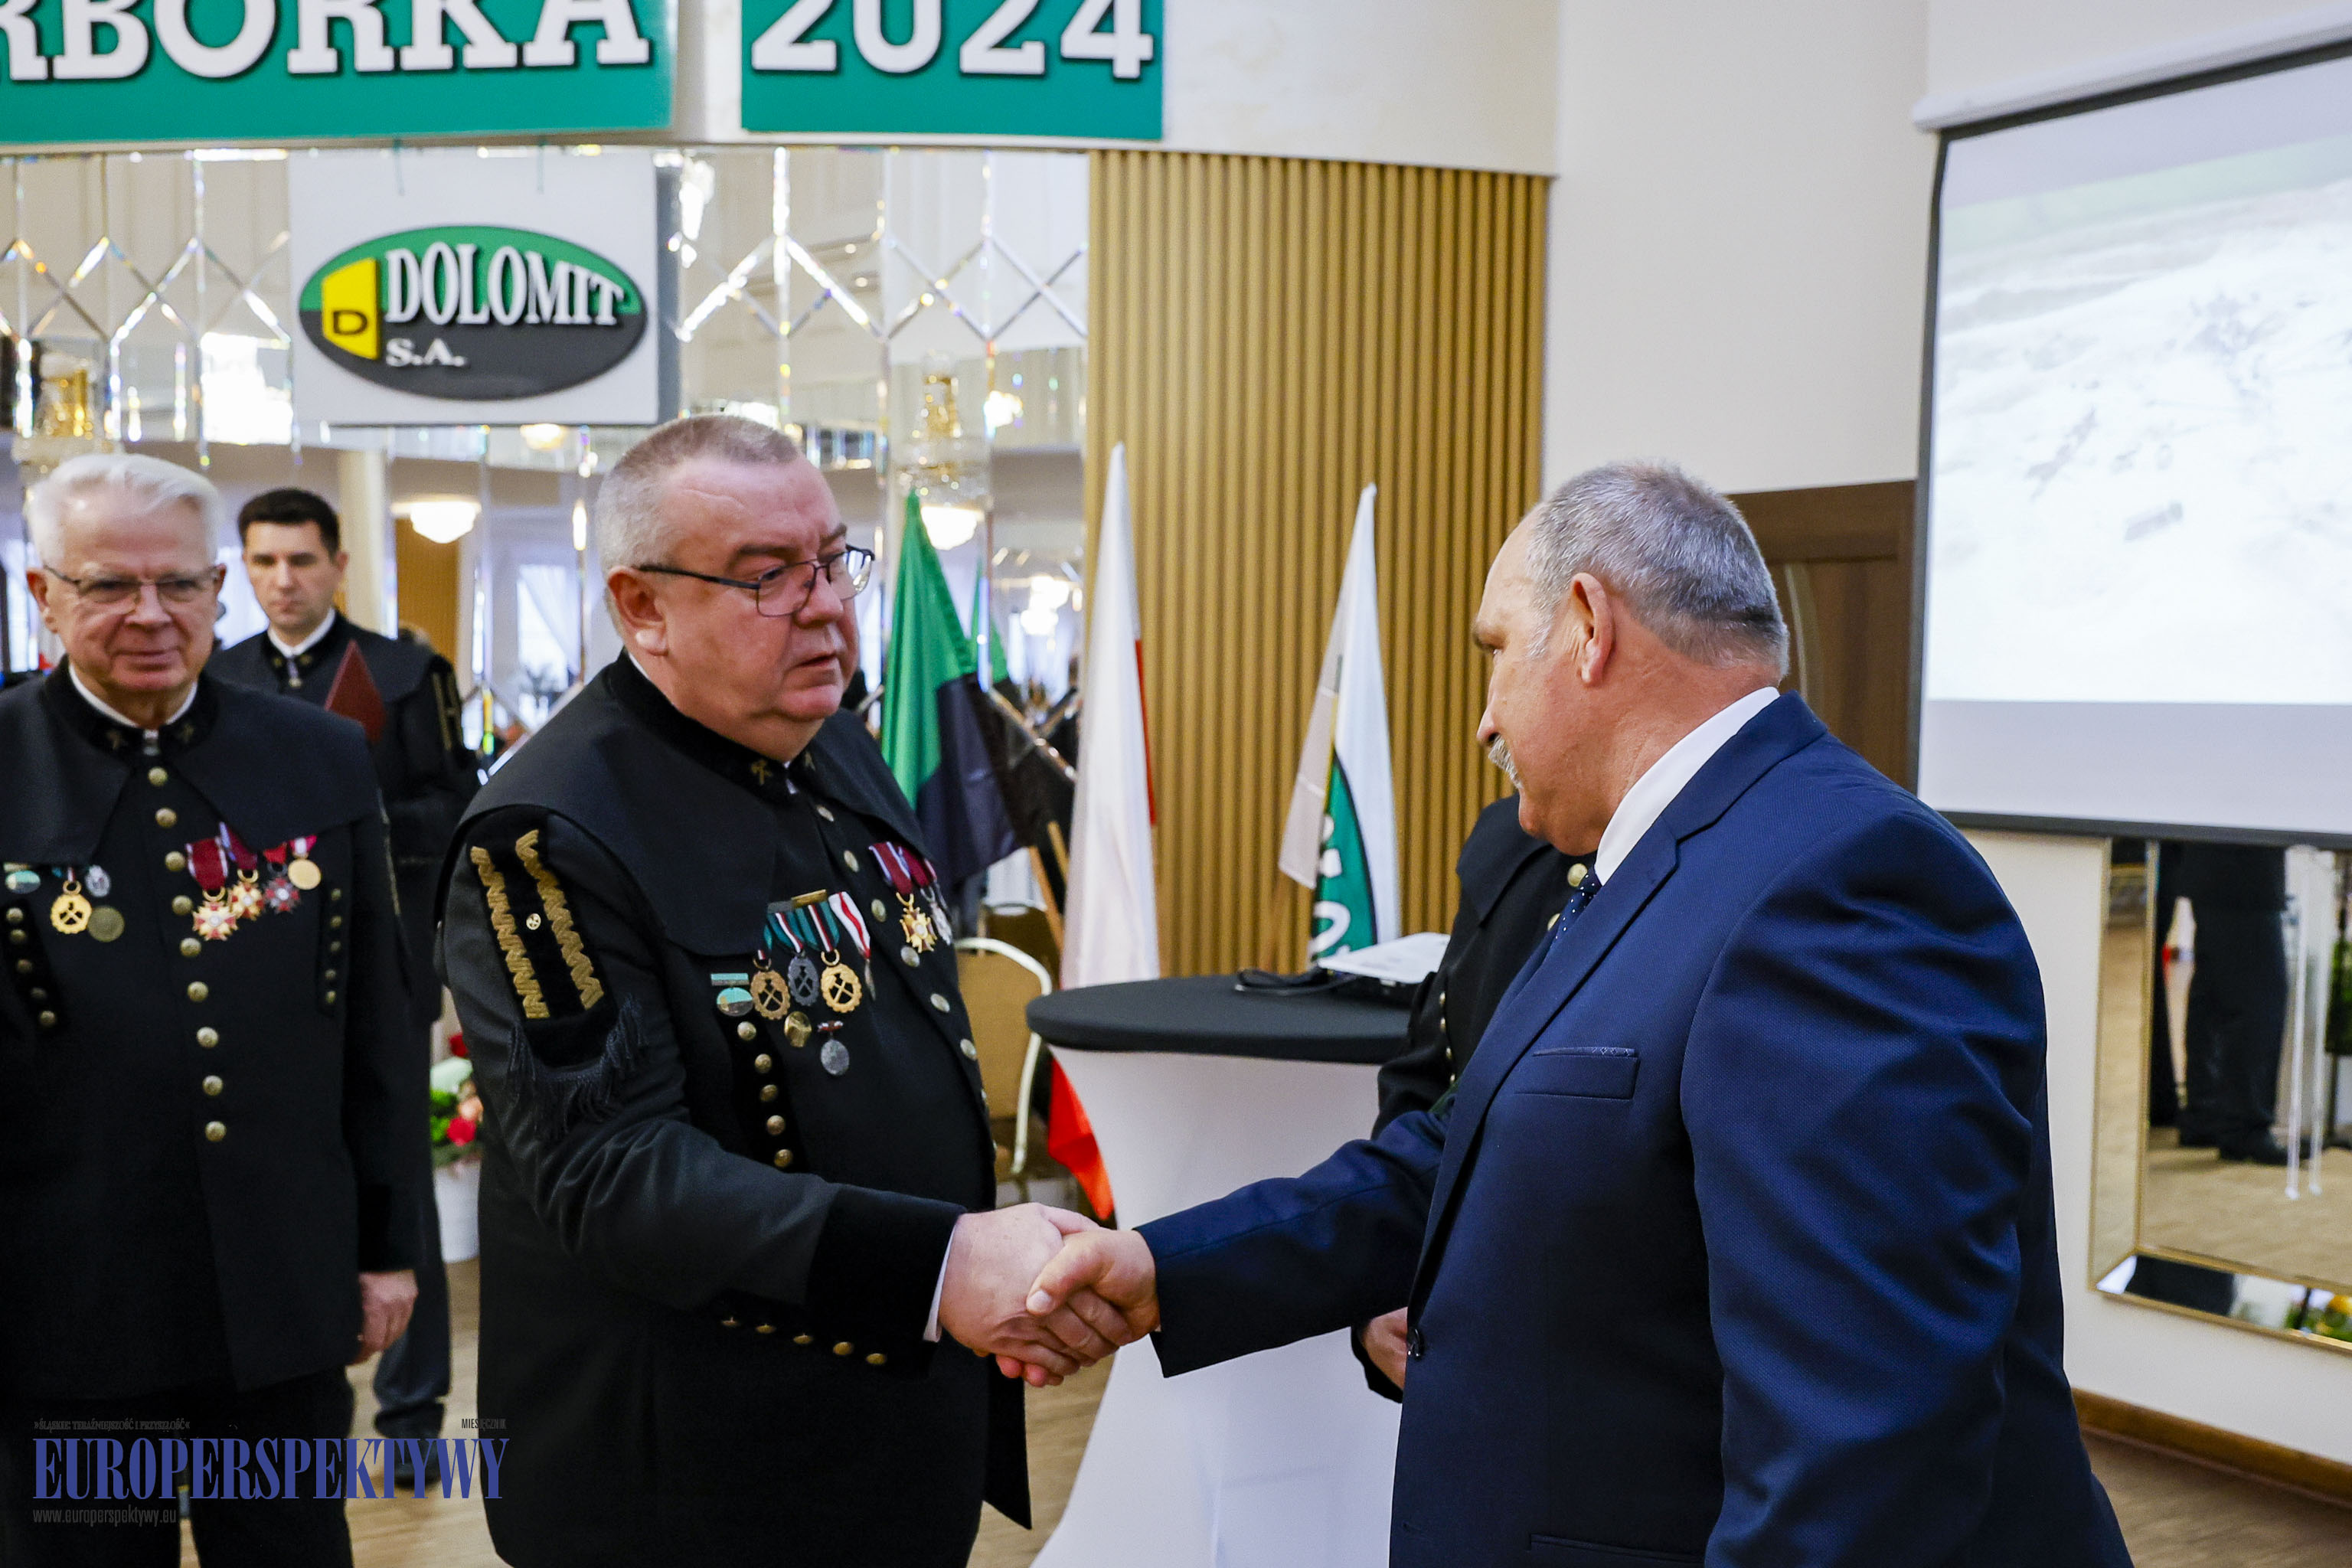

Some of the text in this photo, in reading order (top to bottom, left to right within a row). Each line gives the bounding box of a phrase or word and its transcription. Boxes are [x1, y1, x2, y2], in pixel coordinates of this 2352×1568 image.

[0, 0, 649, 80] BORKA
[751, 0, 1154, 79] 2024
[332, 309, 368, 335] D
[385, 241, 624, 325] DOLOMIT
[386, 337, 467, 367] S.A.
